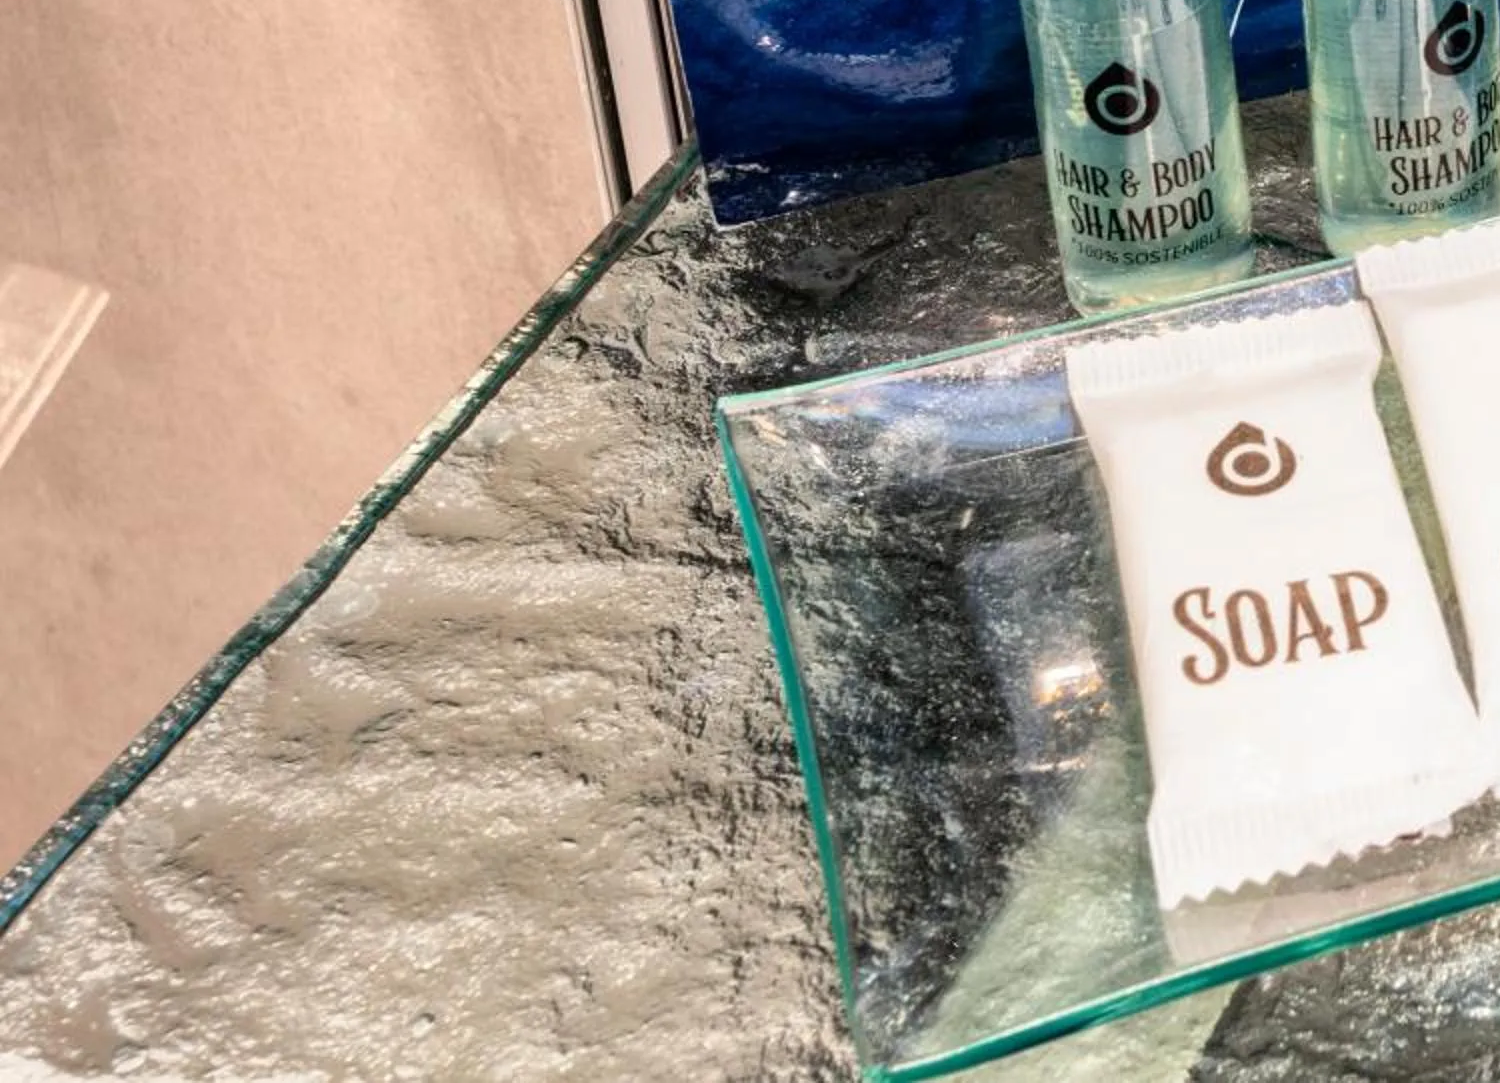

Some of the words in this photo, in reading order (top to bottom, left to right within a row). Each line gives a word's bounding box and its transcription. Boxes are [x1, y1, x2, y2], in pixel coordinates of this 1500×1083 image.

[1374, 116, 1441, 152] HAIR
[1452, 105, 1469, 137] &
[1476, 80, 1499, 127] BO
[1054, 148, 1110, 198] HAIR
[1120, 168, 1141, 198] &
[1152, 136, 1216, 197] BODY
[1068, 188, 1215, 242] SHAMPOO
[1171, 570, 1390, 686] SOAP
